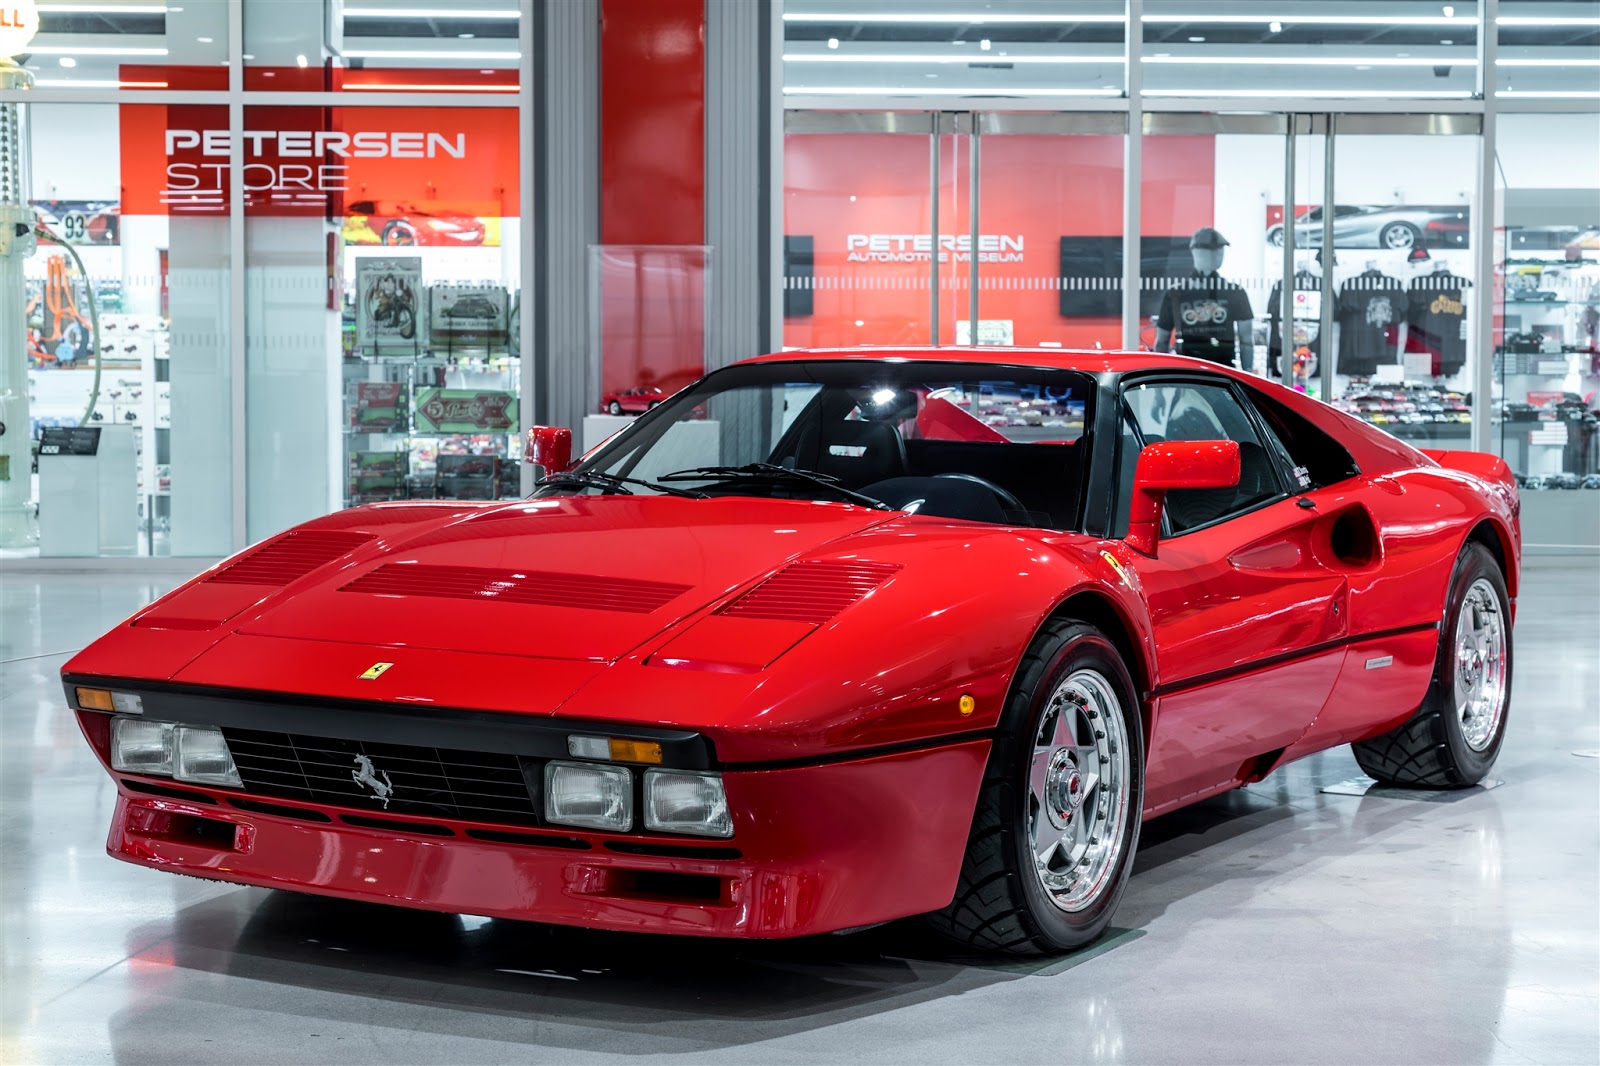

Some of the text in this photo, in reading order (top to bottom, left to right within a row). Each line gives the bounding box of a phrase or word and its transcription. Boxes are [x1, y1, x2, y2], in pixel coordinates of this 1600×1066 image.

[165, 129, 465, 158] PETERSEN
[166, 163, 349, 190] STORE
[65, 215, 85, 239] 93
[847, 234, 1024, 251] PETERSEN
[953, 252, 1024, 263] MSEUM
